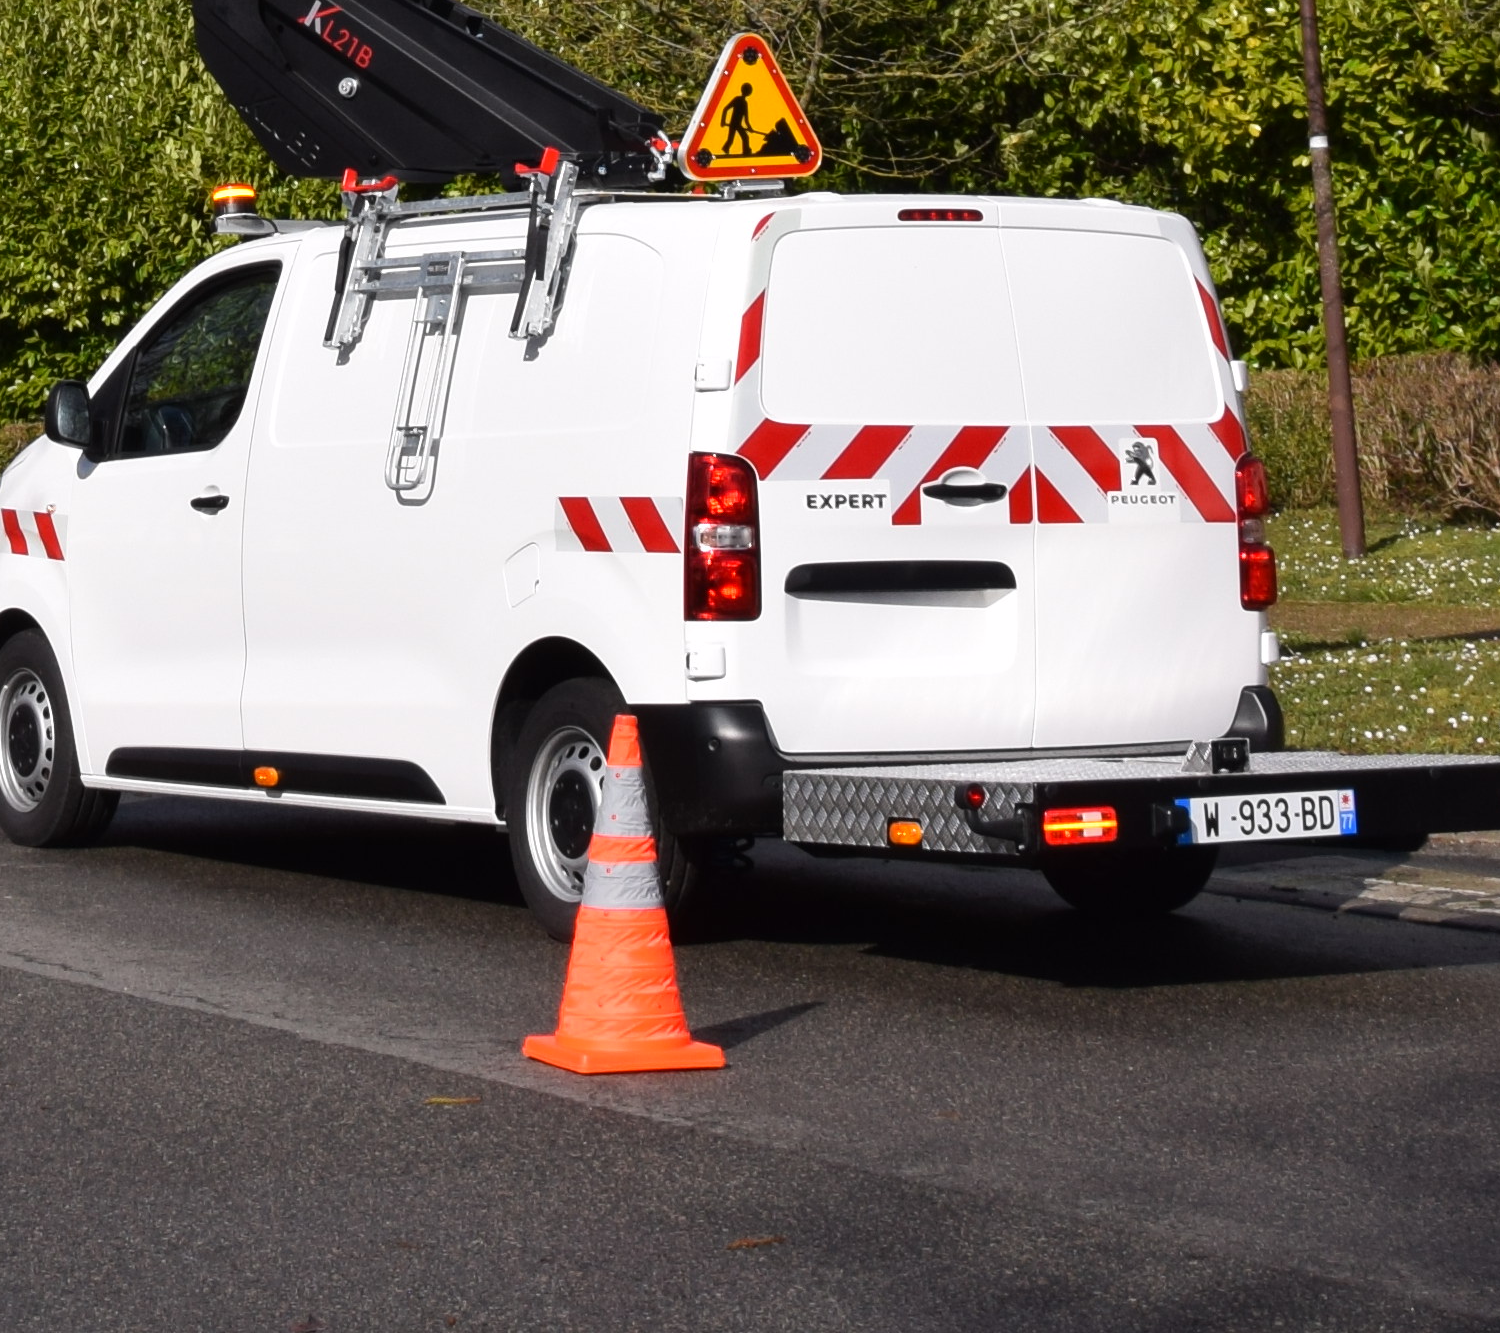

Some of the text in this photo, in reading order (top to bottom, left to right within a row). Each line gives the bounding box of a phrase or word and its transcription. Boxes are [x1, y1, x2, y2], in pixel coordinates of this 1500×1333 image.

[296, 0, 374, 69] KL21B
[806, 494, 887, 509] EXPERT
[1111, 495, 1176, 505] PEUGEOT
[1341, 814, 1354, 829] 77
